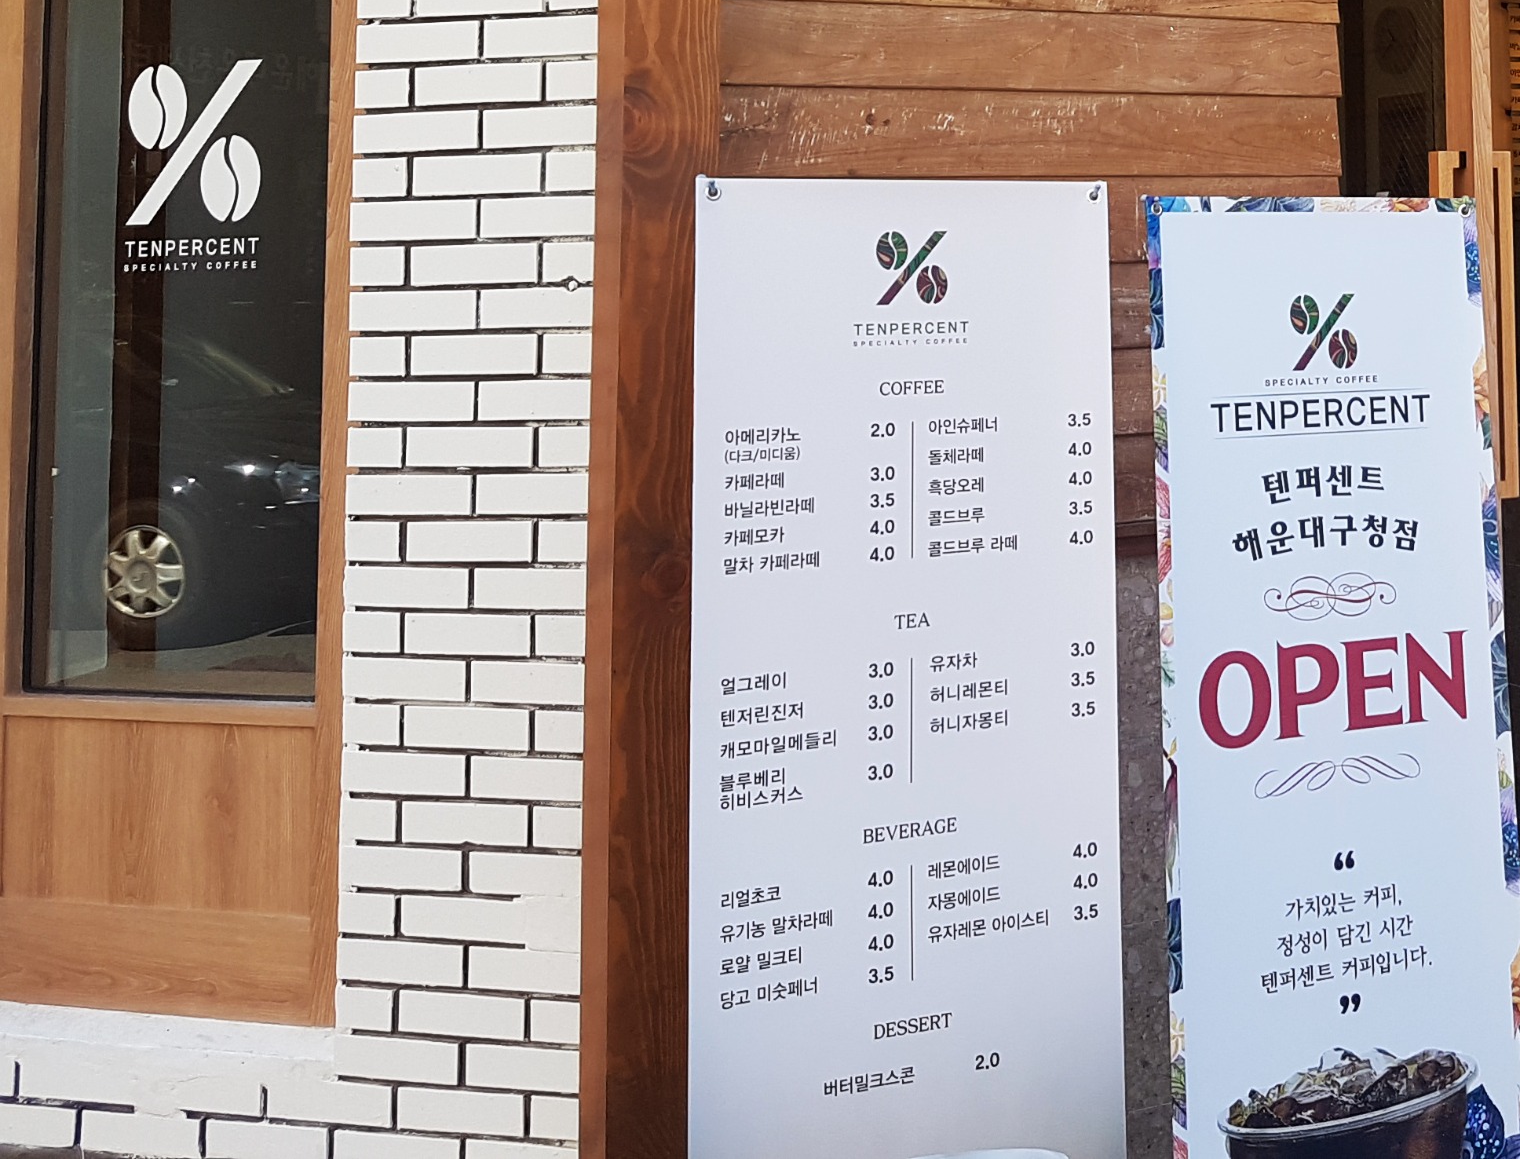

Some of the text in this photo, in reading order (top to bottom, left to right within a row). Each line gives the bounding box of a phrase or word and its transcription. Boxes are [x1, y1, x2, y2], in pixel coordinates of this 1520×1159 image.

[124, 237, 260, 258] TENPERCENT
[123, 260, 257, 272] SPECIALTY COFFEE
[852, 337, 968, 347] SPECIALTY COFFEE
[853, 321, 969, 336] TENPERCENT
[879, 379, 945, 397] COFFEE
[1264, 375, 1378, 387] SPECIALTY COFFEE
[928, 412, 1092, 435] 아인슈페너 3.5
[1210, 394, 1431, 433] TENPERCENT
[725, 422, 896, 444] 아메리카노 2.0
[928, 441, 1092, 466] 돌체라떼 4.0
[725, 465, 895, 492] 카페라떼 3.0
[928, 470, 1093, 496] 흑당오레 4.0
[1261, 465, 1385, 505] 텐퍼센트
[724, 492, 895, 519] 바닐라빈라떼 3.5
[928, 500, 1093, 527] 콜드브루 3.5
[724, 519, 895, 547] 카페모카 4.0
[927, 529, 1094, 558] 콜드브루 라떼 4.0
[1231, 514, 1419, 561] 해운대구청점
[723, 546, 895, 576] 말차 카페라떼 4.0
[893, 612, 931, 630] TEA
[929, 641, 1095, 673] 유자차 3.0
[721, 661, 894, 696] 얼그레이 3.0
[930, 671, 1095, 703] 허니레몬티 3.5
[1198, 629, 1469, 749] OPEN
[720, 692, 894, 726] 텐저린진저 3.0
[930, 701, 1096, 734] 허니자몽티 3.5
[720, 724, 894, 759] 캐모마일메들리 3.0
[719, 763, 894, 792] 블루베리 3.0
[719, 785, 803, 811] 히비스커스
[863, 816, 957, 844] BEVERAGE
[928, 841, 1098, 879] 레몬에이드 4.0
[721, 870, 894, 910] 리얼초코 4.0
[927, 872, 1098, 911] 자몽에이드 4.0
[1285, 883, 1402, 921] 가치있는 커피,
[719, 901, 894, 944] 유기농 말차라떼 4.0
[927, 903, 1099, 944] 유자레몬 아이스티 3.5
[1277, 914, 1414, 957] 정성이 담긴 시간
[719, 933, 894, 976] 로얄 밀크티 4.0
[1260, 945, 1432, 994] 텐퍼센트 커피입니다.
[720, 965, 894, 1010] 당고 미숫페너 3.5
[873, 1012, 953, 1040] DESSERT
[823, 1052, 1000, 1097] 버터밀크스콘 2.0
